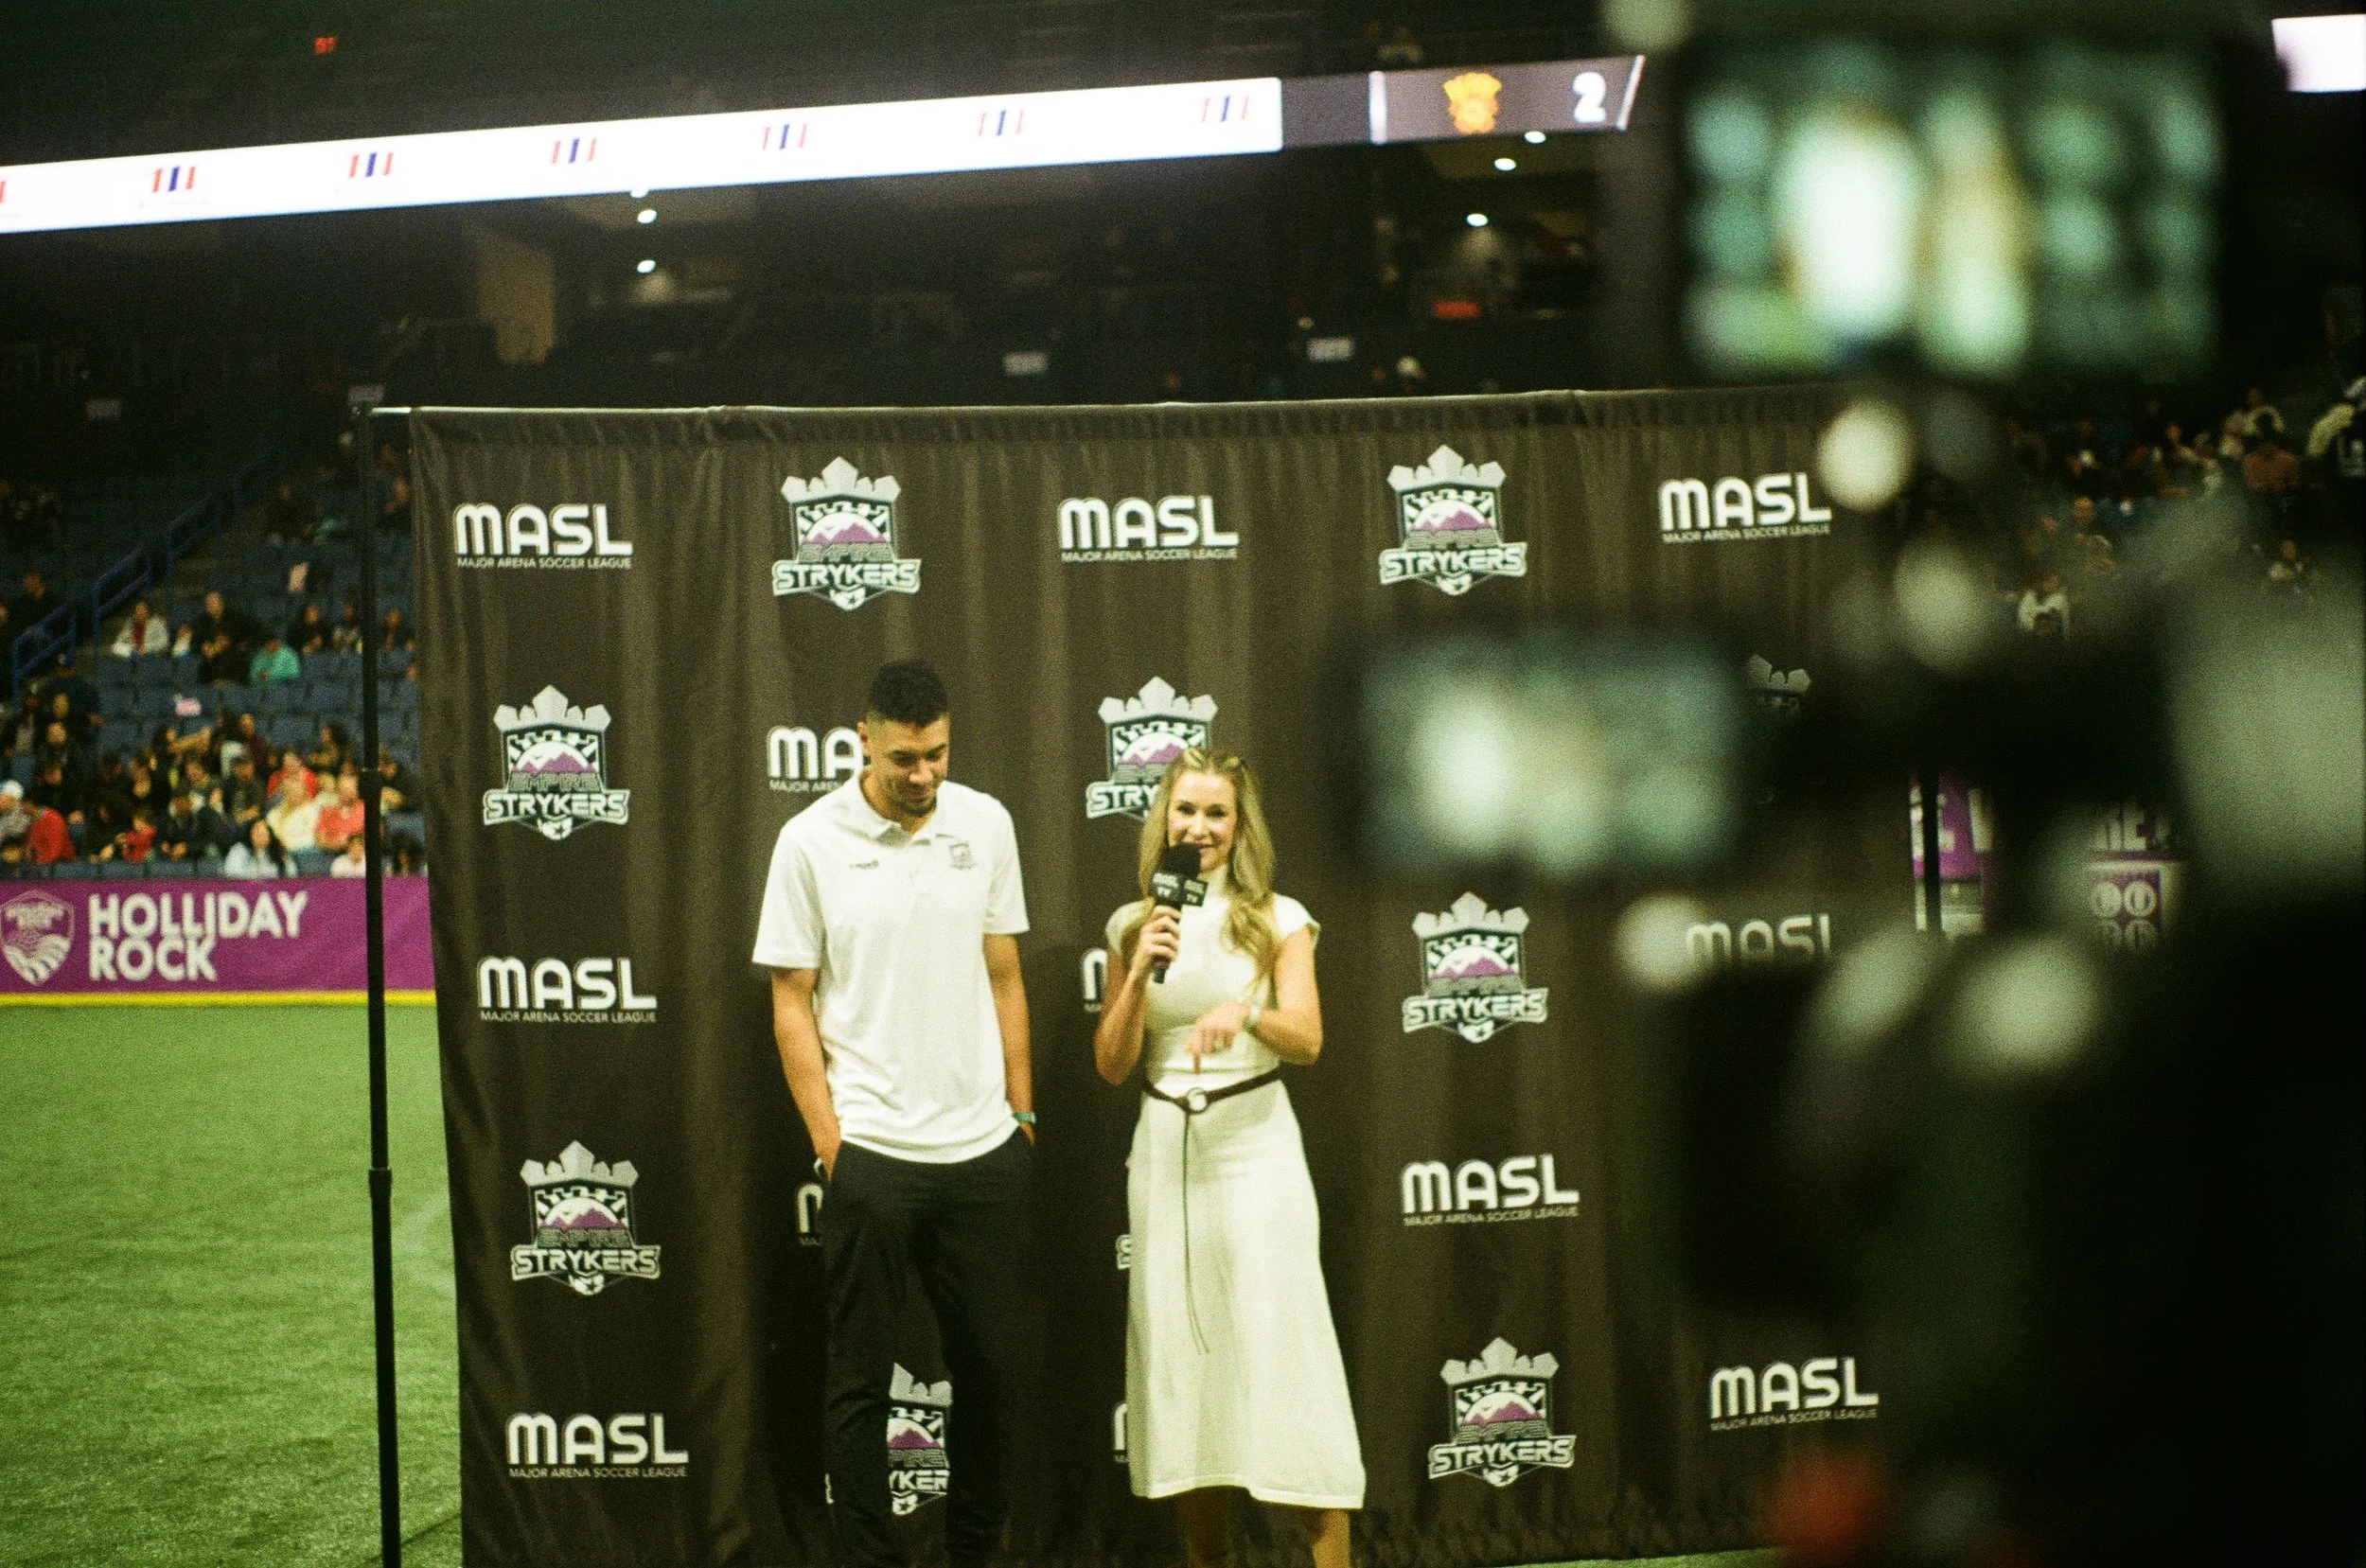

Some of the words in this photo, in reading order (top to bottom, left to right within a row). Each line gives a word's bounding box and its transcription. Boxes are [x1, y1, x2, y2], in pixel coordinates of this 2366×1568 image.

[1572, 71, 1607, 124] 2
[1057, 495, 1240, 549] MASL
[1659, 472, 1832, 531] MASL
[452, 502, 633, 555] MASL
[457, 556, 495, 568] MAJOR
[497, 556, 537, 569] ARENA
[539, 556, 585, 569] SOCCER
[587, 556, 632, 569] LEAGUE
[775, 563, 917, 590] STRYKERS
[1383, 546, 1524, 578] STRYKERS
[486, 792, 627, 819] STRYKERS
[88, 890, 309, 939] HOLLIDAY
[88, 934, 218, 982] ROCK
[477, 956, 658, 1009] MASL
[480, 1010, 520, 1022] MAJOR
[522, 1011, 560, 1023] ARENA
[562, 1011, 608, 1023] SOCCER
[610, 1011, 656, 1024] LEAGUE
[1405, 992, 1545, 1026] STRYKERS
[1402, 1152, 1580, 1213] MASL
[515, 1248, 656, 1275] STRYKERS
[1710, 1357, 1880, 1419] MASL
[505, 1412, 689, 1465] MASL
[1433, 1438, 1574, 1473] STRYKERS
[508, 1468, 548, 1478] MAJOR
[550, 1468, 591, 1478] ARENA
[593, 1468, 639, 1478] SOCCER
[641, 1467, 688, 1478] LEAGUE
